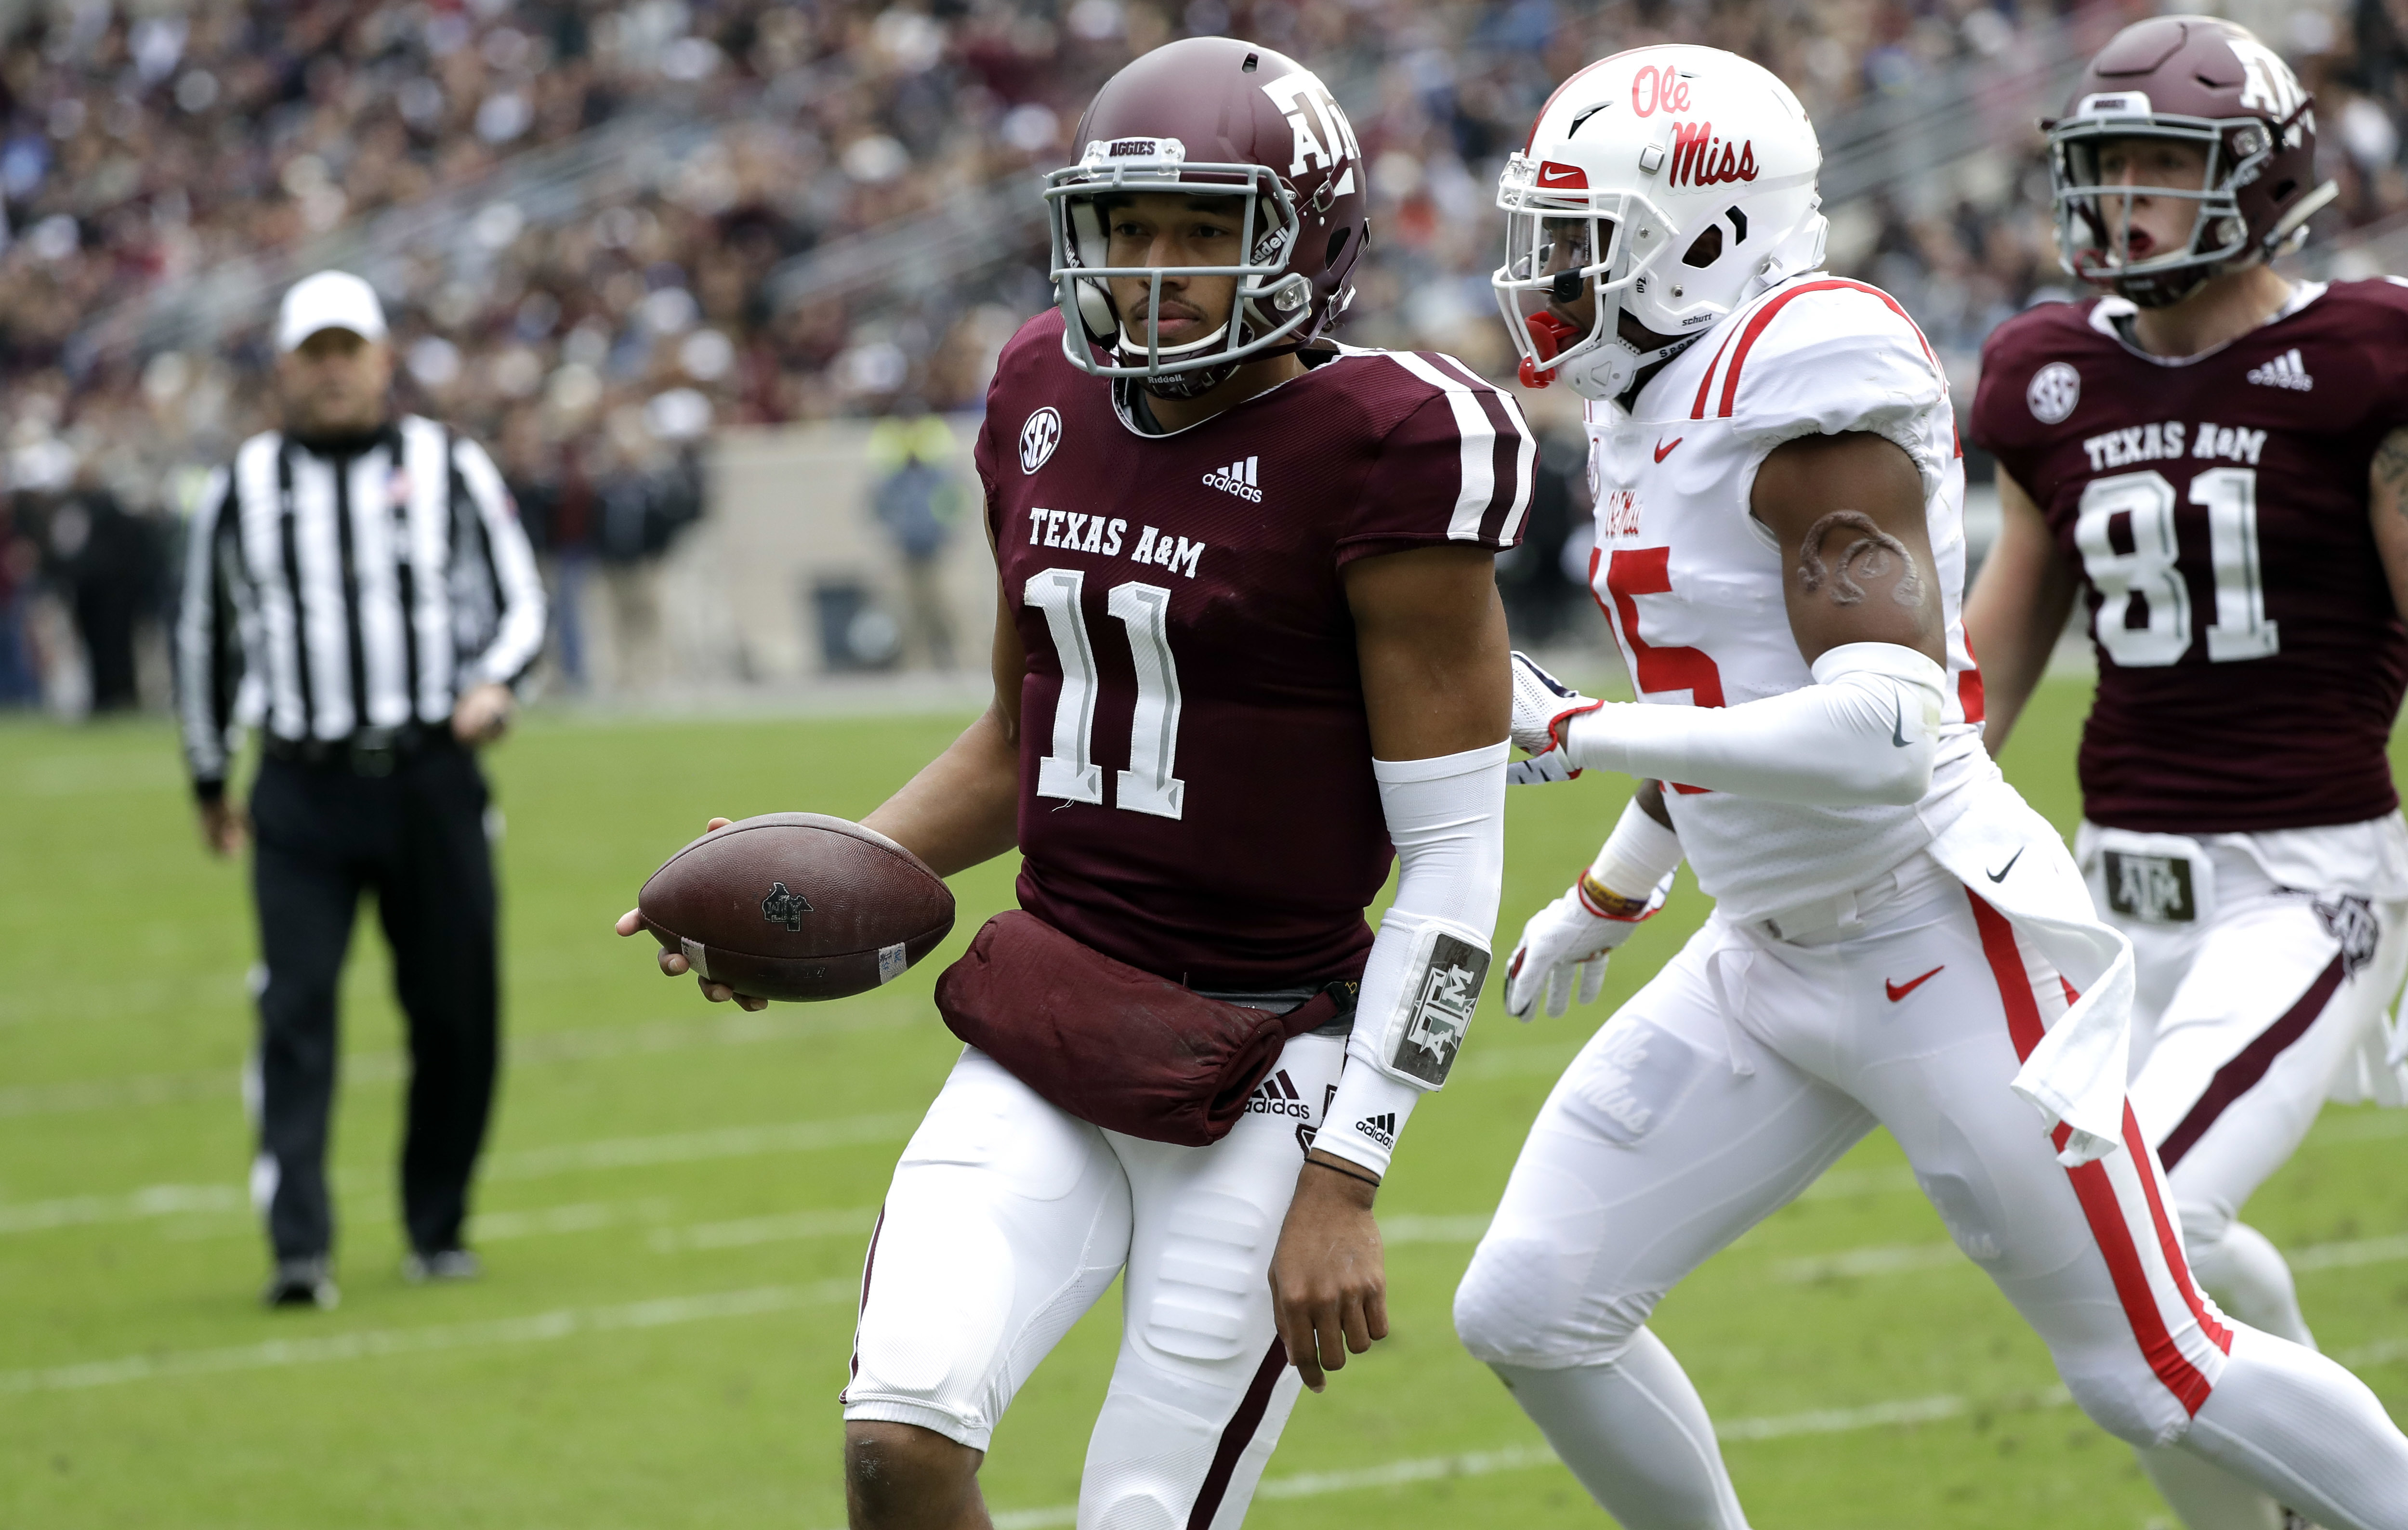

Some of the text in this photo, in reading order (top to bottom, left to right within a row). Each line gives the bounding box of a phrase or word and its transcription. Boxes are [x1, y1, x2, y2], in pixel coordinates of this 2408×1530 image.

[1632, 65, 1691, 118] Ole
[1109, 141, 1156, 157] AGGIES
[1669, 121, 1760, 189] Miss
[1250, 226, 1289, 264] iddell
[1681, 313, 1712, 331] schutt
[1147, 374, 1183, 383] Riddell
[1023, 412, 1057, 469] SEC
[2083, 420, 2268, 471] TEXAS A&M
[1202, 473, 1263, 503] adidas
[1029, 507, 1206, 579] TEXAS A&M
[2074, 467, 2280, 667] 81
[1024, 567, 1185, 821] 11
[1355, 1121, 1394, 1151] adidas
